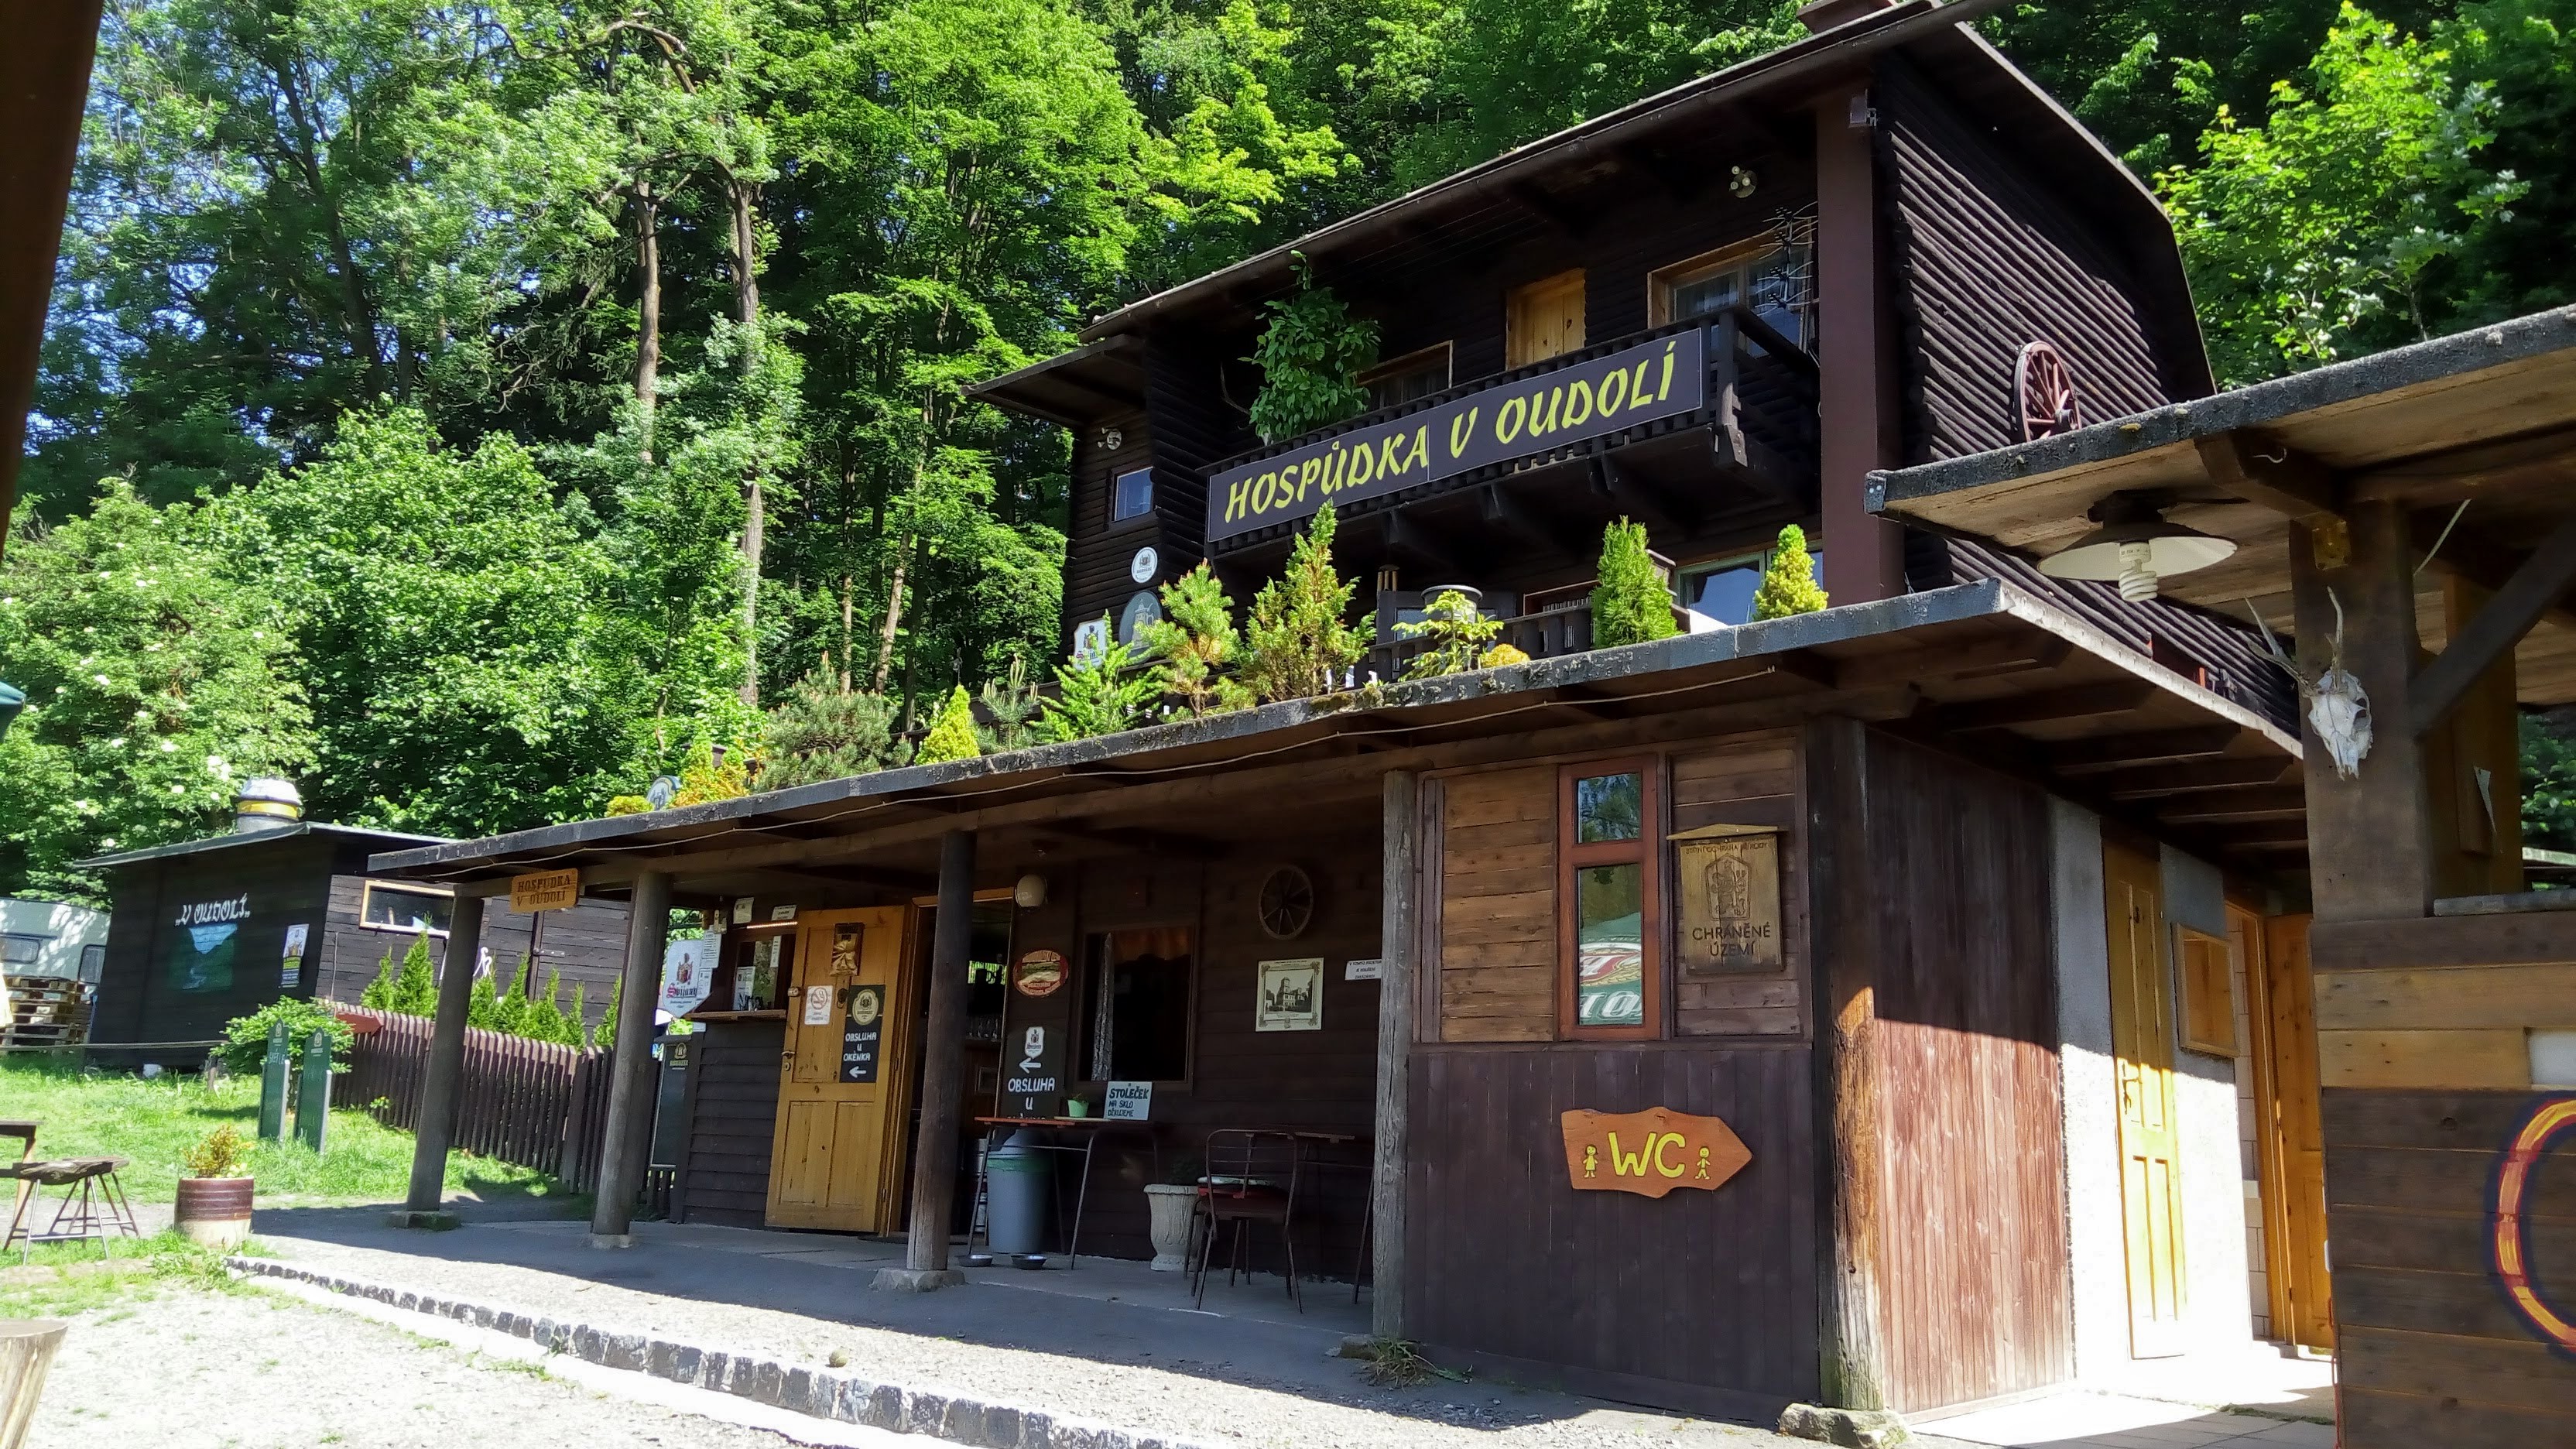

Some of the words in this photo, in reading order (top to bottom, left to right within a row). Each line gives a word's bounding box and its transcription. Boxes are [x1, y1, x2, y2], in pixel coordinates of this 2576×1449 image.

[1225, 425, 1428, 524] HOSPŮDKA
[1450, 406, 1478, 460] V
[1495, 341, 1677, 445] OUDOLÍ
[1692, 921, 1771, 941] CHRÁNĚNÉ
[1710, 940, 1756, 957] ÚZEMÍ
[845, 1032, 876, 1042] OBSLUHA
[1008, 1077, 1055, 1092] OBSLUHA
[1109, 1086, 1149, 1099] STOLEČEK
[1608, 1131, 1687, 1179] WC
